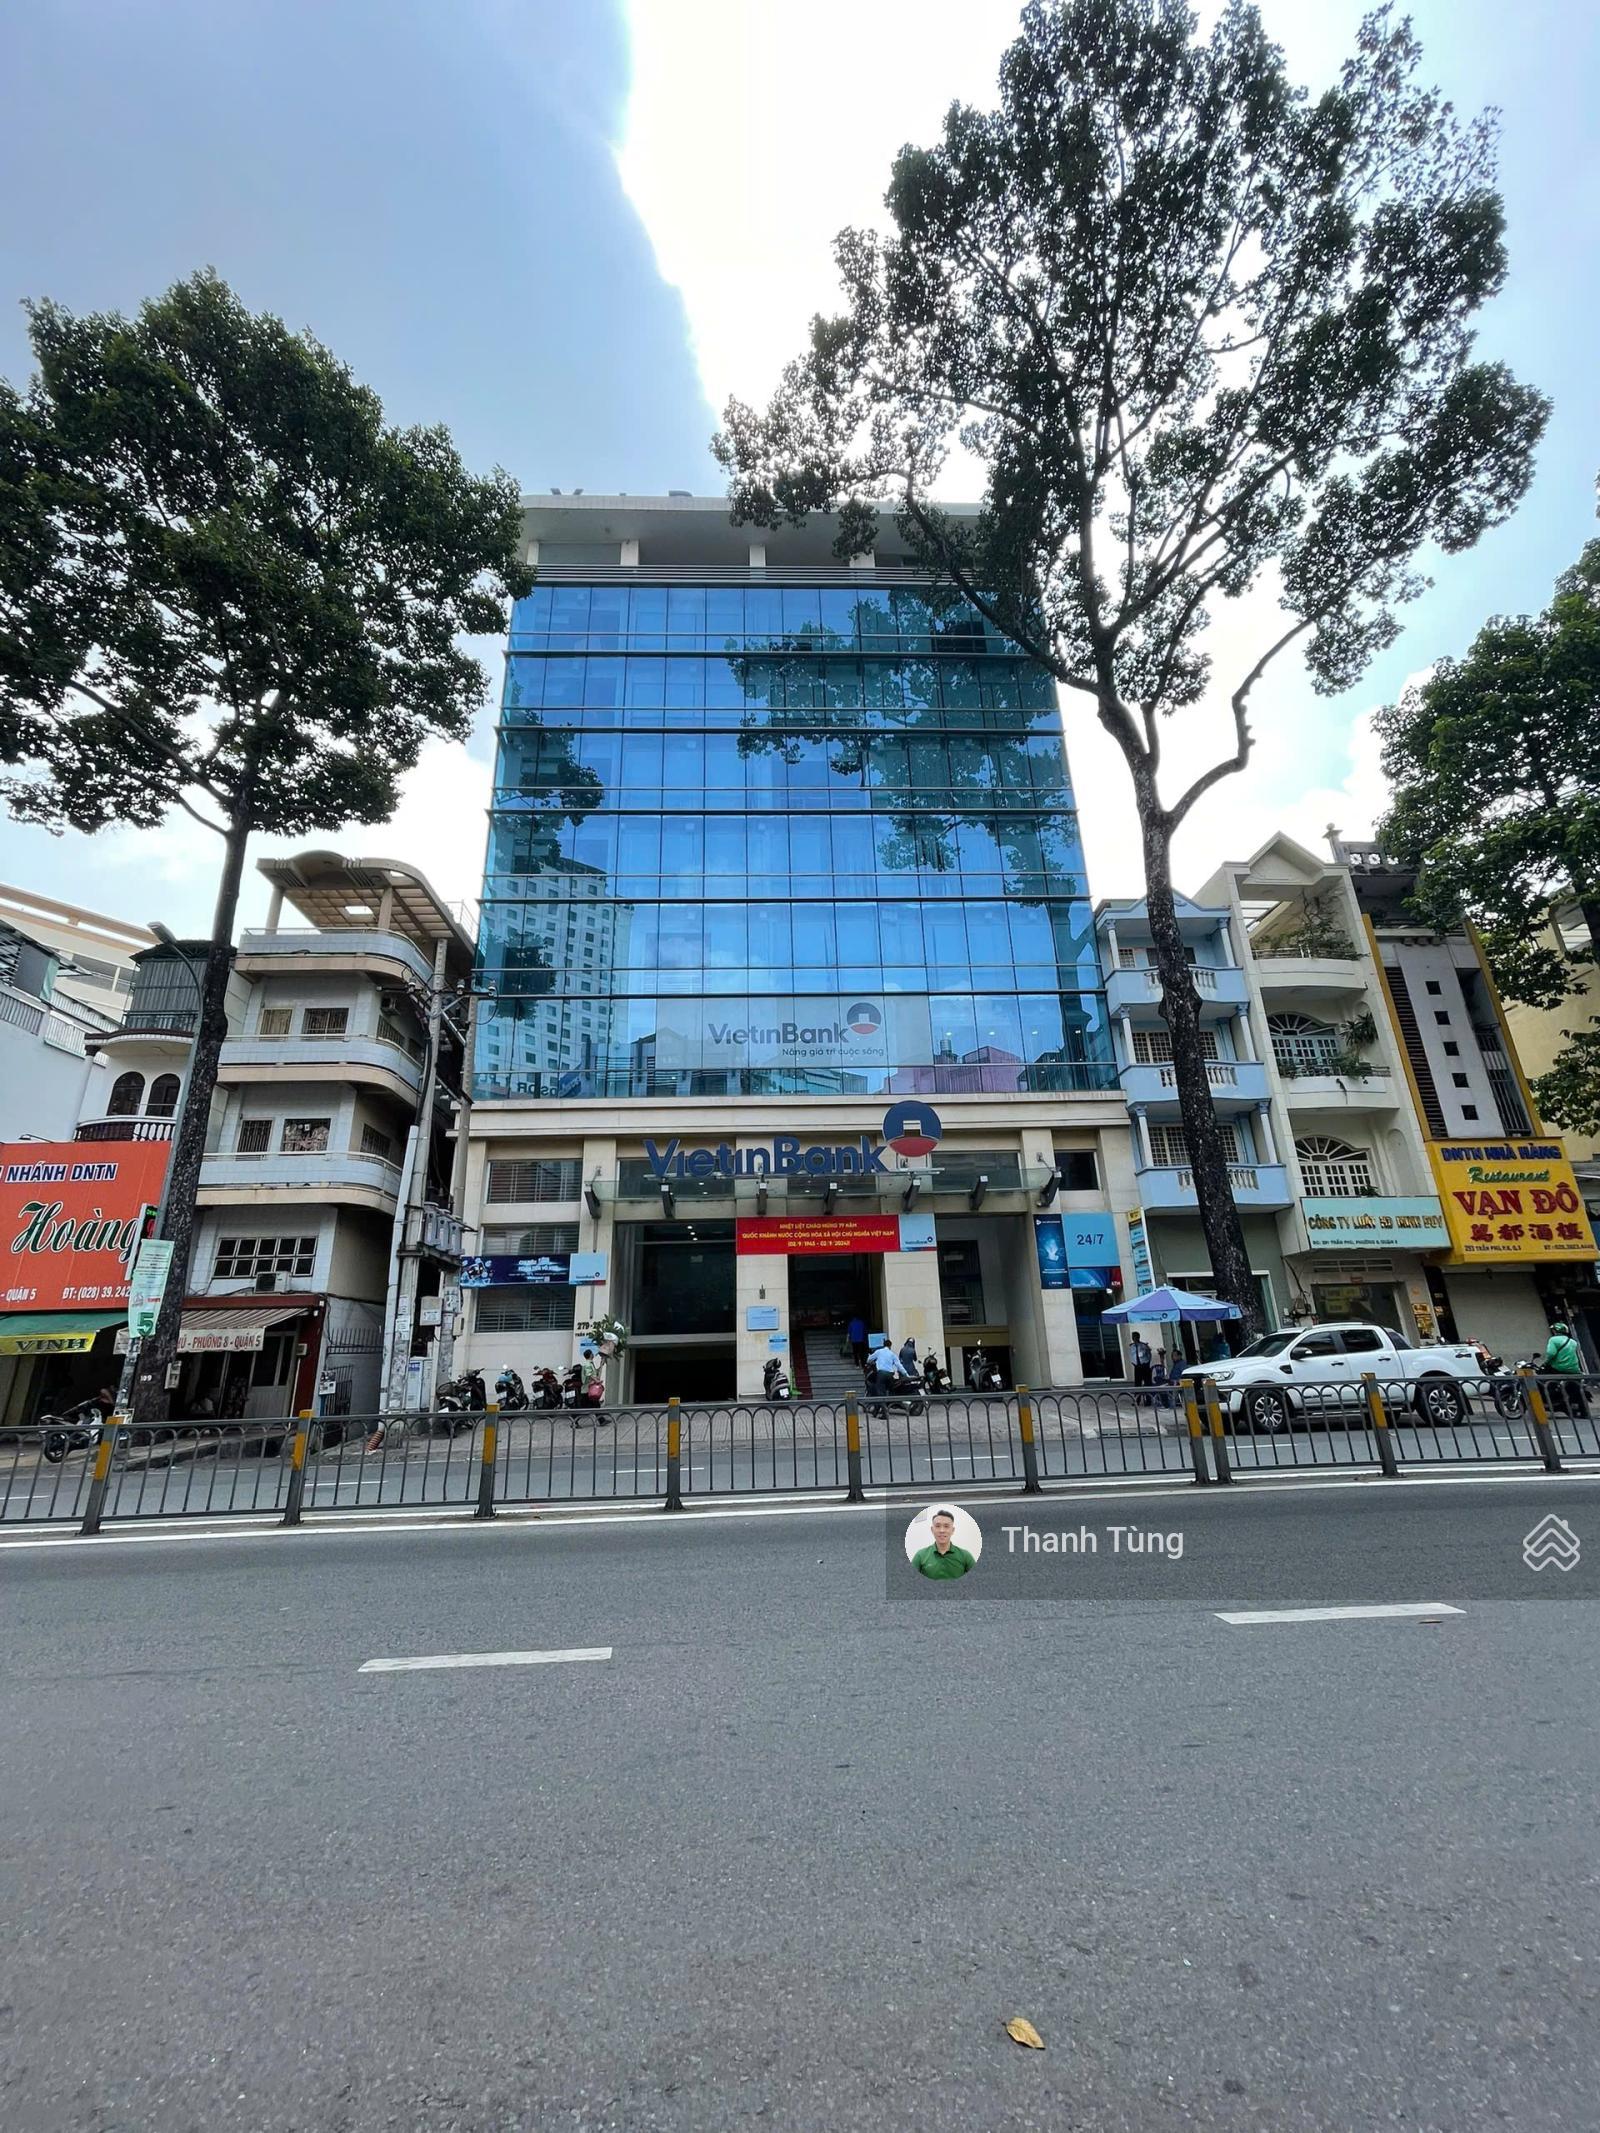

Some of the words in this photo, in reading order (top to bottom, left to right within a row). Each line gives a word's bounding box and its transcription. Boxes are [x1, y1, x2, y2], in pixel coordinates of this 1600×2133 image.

[708, 1022, 849, 1045] VietinBank
[643, 1135, 890, 1178] VietinBank
[1441, 1147, 1483, 1161] DNTN
[1484, 1143, 1517, 1161] NHÀ
[1518, 1143, 1562, 1160] HÀNG
[5, 1161, 68, 1183] NHÁNH
[70, 1163, 118, 1181] DNTN
[1468, 1166, 1550, 1185] Restaurant
[1453, 1190, 1523, 1220] VẠN
[1530, 1182, 1579, 1214] ĐÔ
[1309, 1214, 1335, 1230] CÔNG
[1337, 1216, 1350, 1229] TY
[11, 1201, 139, 1264] Hoàng
[1076, 1233, 1104, 1246] 24/7
[6, 1287, 30, 1302] QUẬN
[30, 1289, 37, 1300] 5
[63, 1287, 77, 1299] ĐT:
[78, 1286, 100, 1301] (028)
[16, 1339, 87, 1351] VINH
[255, 1335, 261, 1347] 5
